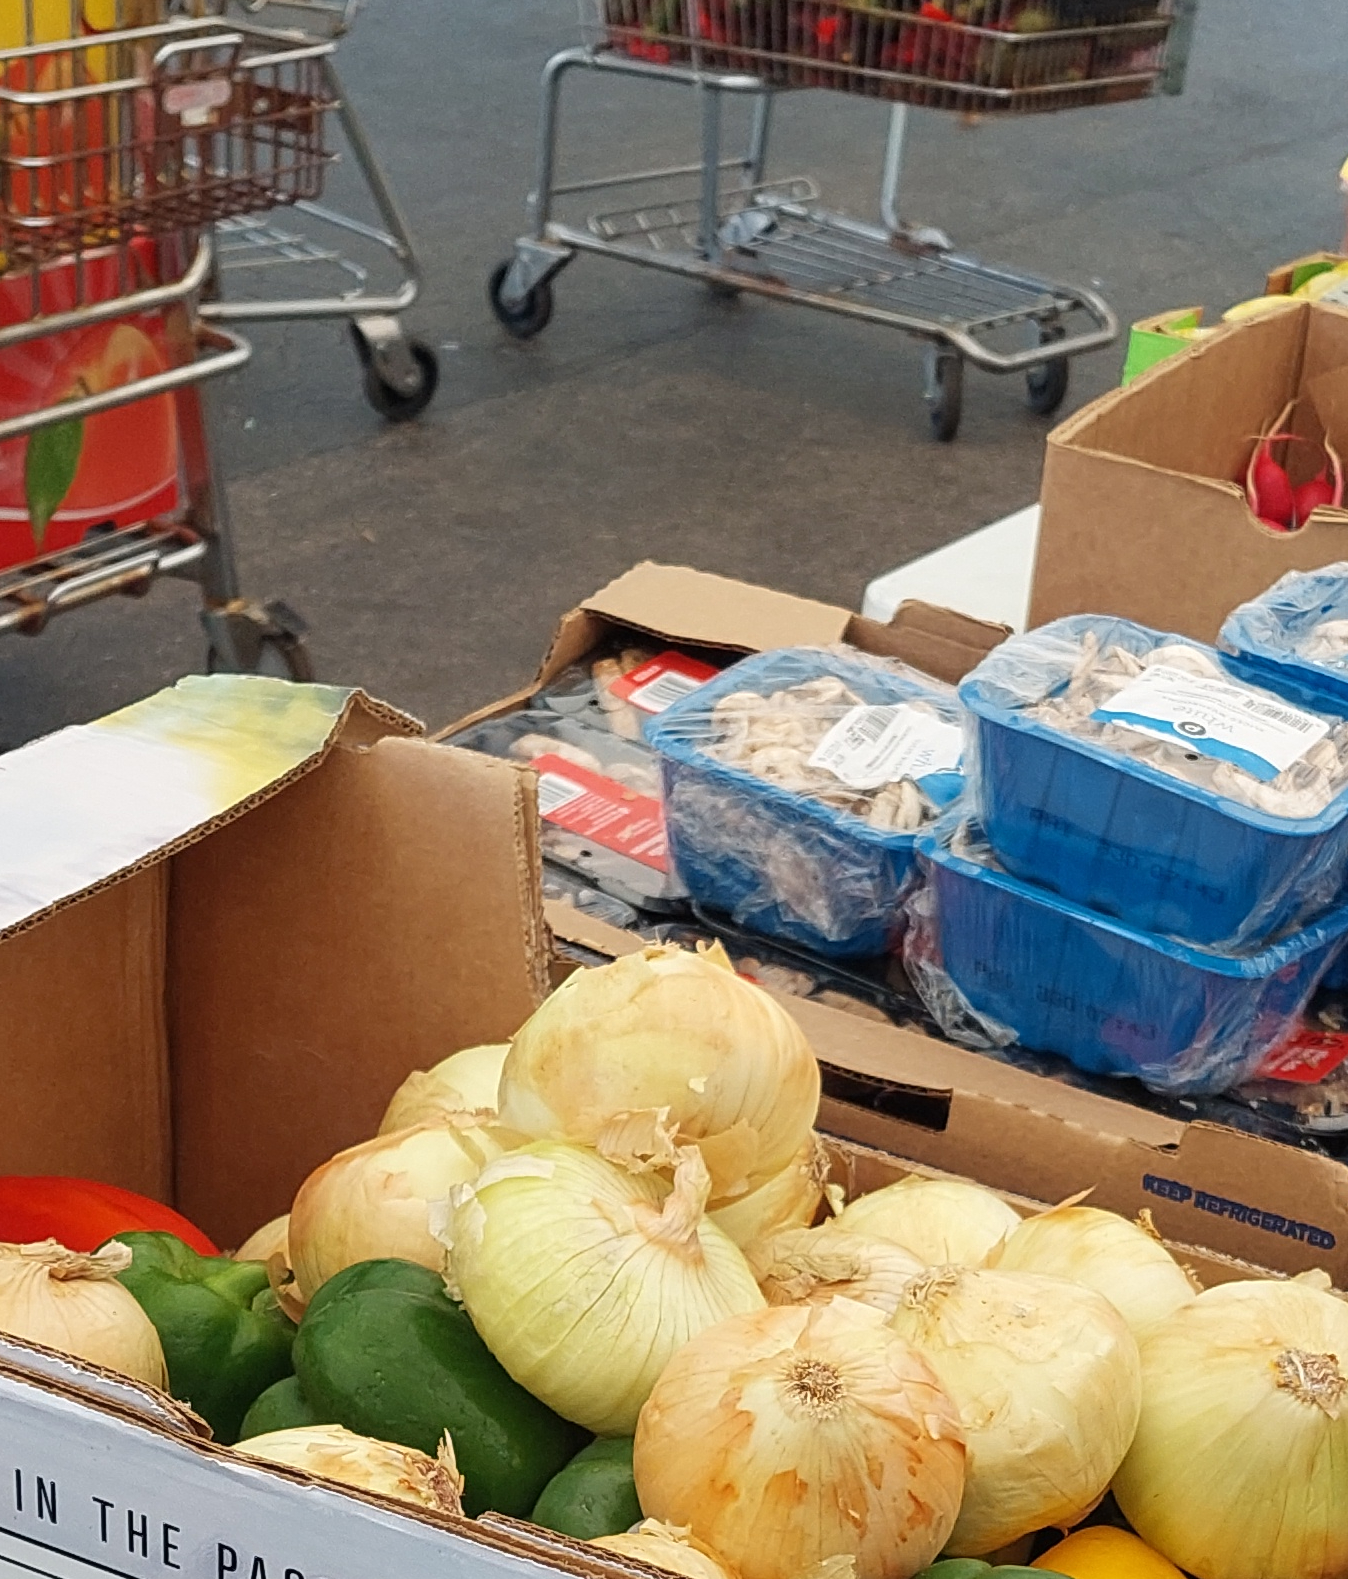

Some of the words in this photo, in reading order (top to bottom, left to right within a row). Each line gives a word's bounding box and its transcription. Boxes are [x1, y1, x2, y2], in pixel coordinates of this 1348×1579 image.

[1142, 1173, 1193, 1204] KEEP
[1193, 1190, 1337, 1250] REFRIGERATED
[14, 1467, 58, 1525] IN
[92, 1494, 183, 1571] THE
